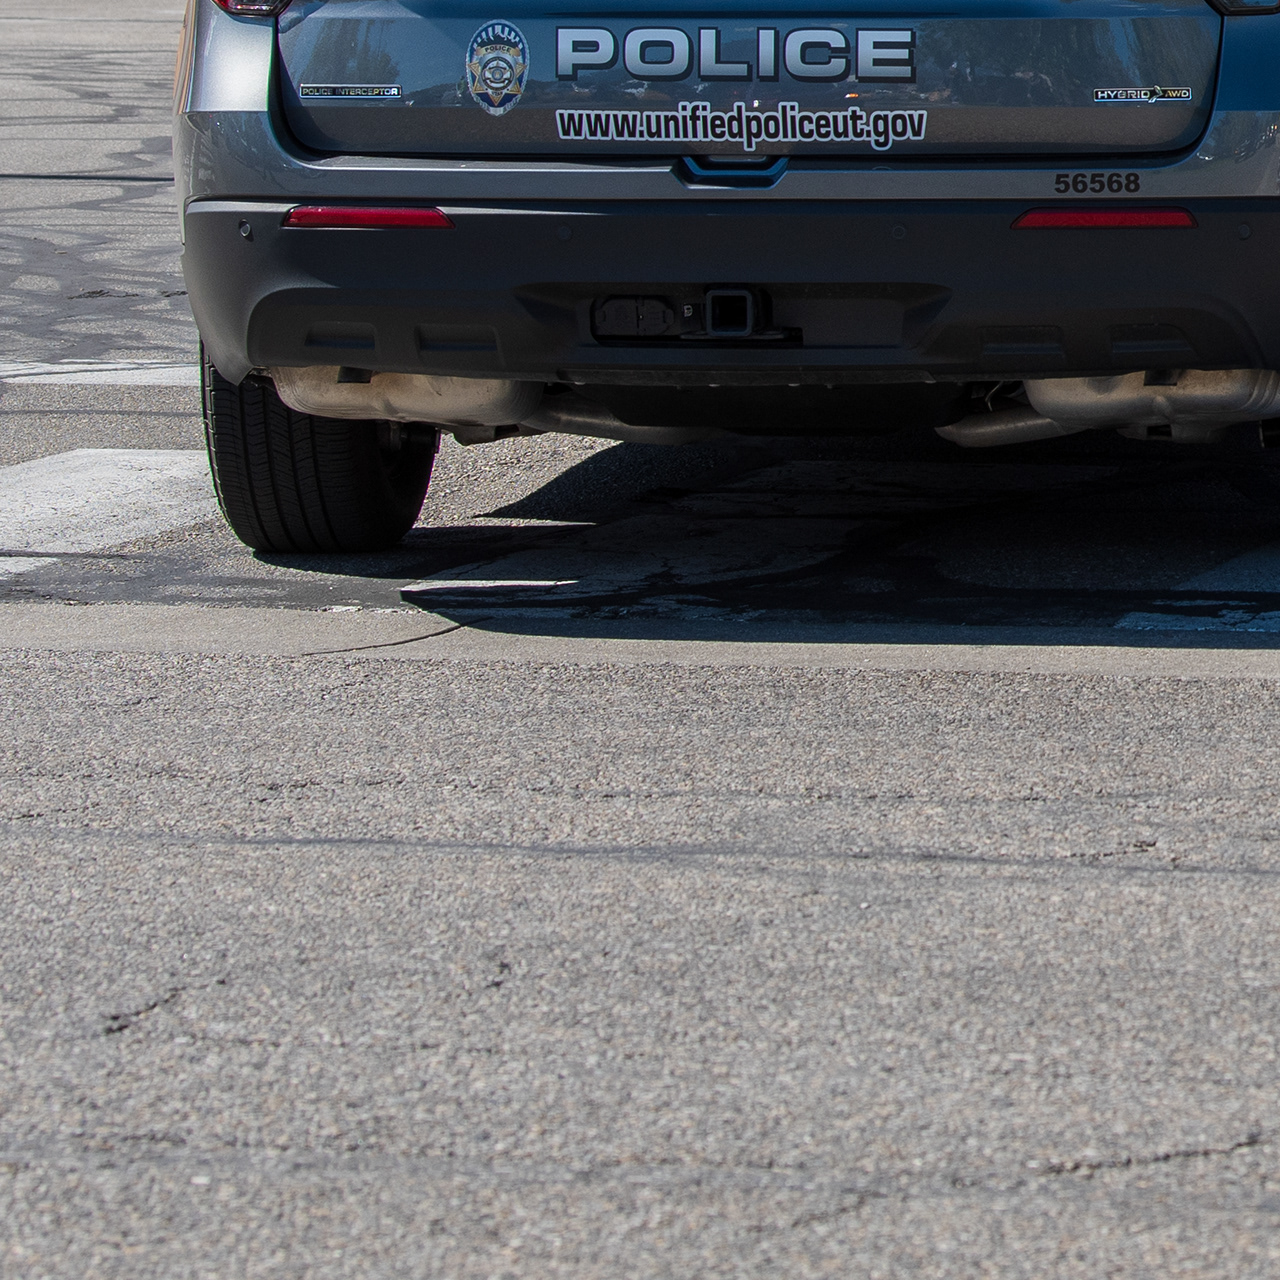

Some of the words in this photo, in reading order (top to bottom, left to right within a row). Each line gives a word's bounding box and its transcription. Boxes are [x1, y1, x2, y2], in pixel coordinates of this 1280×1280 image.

[556, 26, 915, 82] POLICE
[302, 87, 333, 96] POLICE
[336, 87, 398, 96] INTERCEPTOR
[1097, 90, 1150, 99] HYBRID
[1165, 90, 1189, 98] AWD
[557, 102, 926, 150] www.unifiedpoliceut.gov
[1054, 172, 1141, 194] 56568
